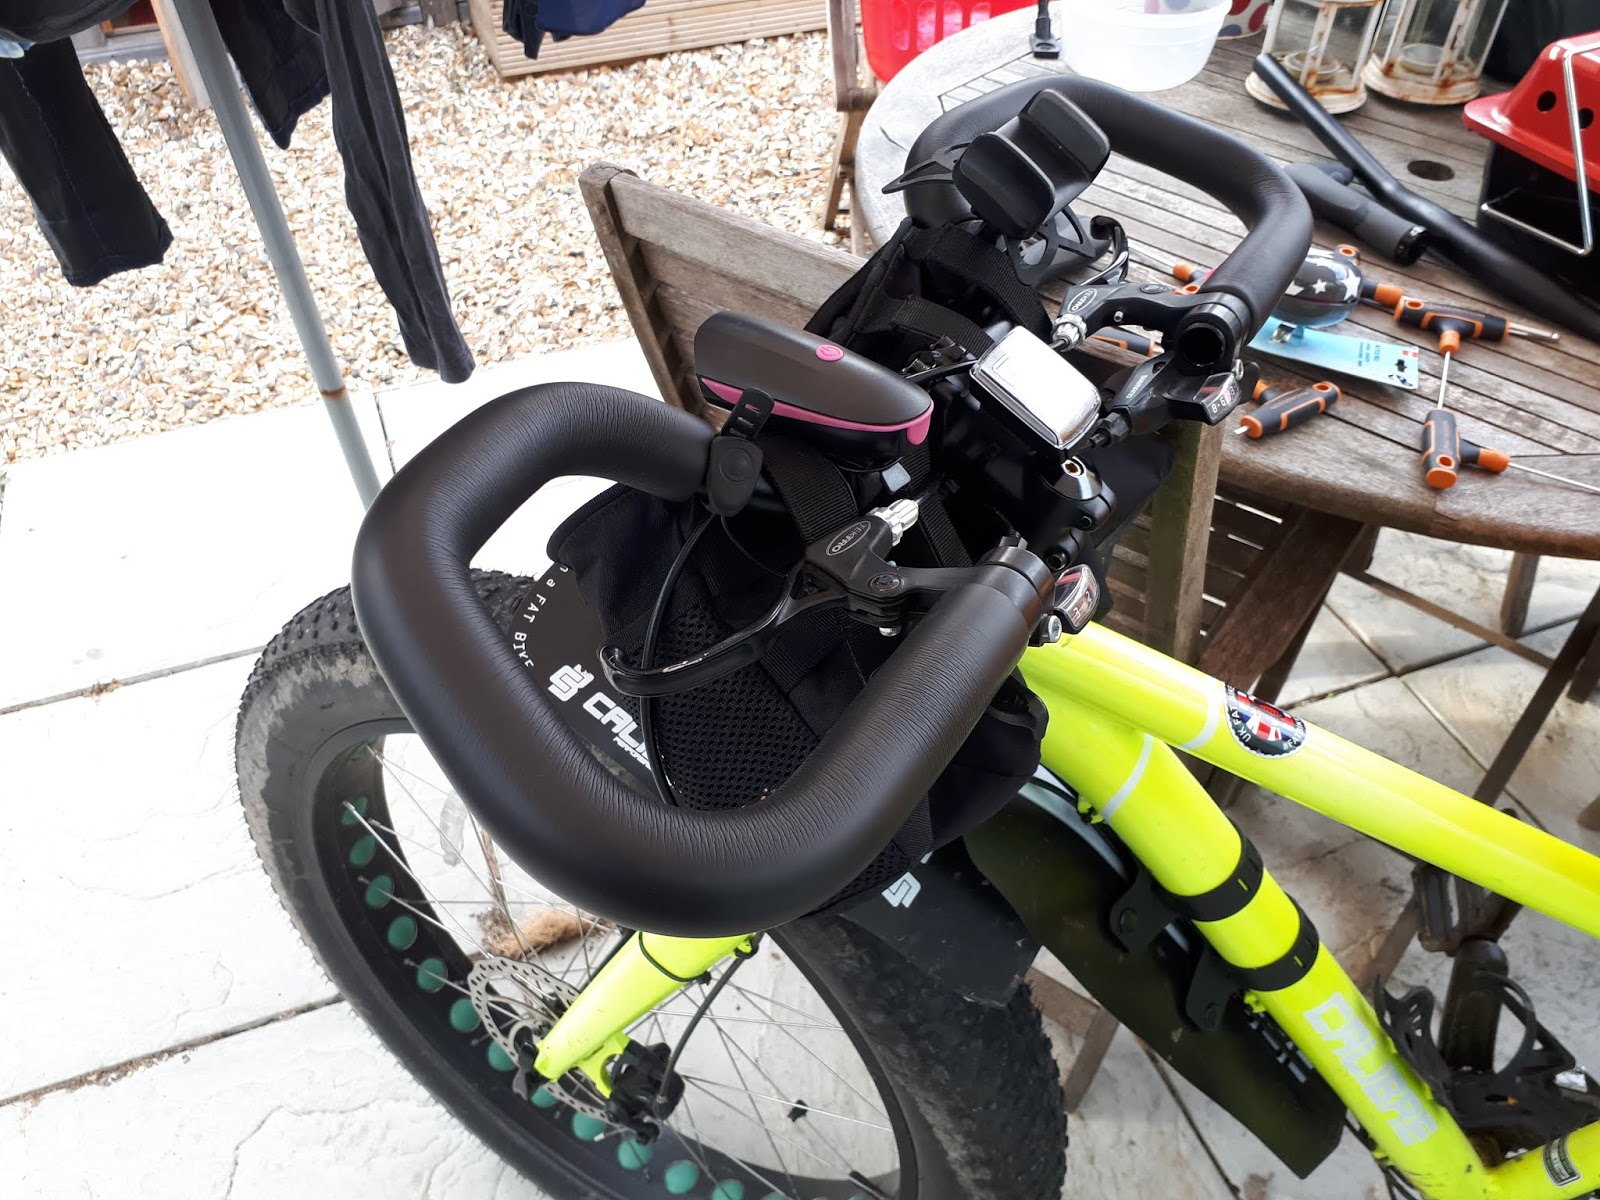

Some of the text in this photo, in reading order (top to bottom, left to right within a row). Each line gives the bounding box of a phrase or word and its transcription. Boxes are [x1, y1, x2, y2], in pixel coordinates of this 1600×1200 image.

[1071, 289, 1095, 311] TEKTRO
[832, 523, 868, 553] TEKTRO
[523, 593, 547, 623] FAT
[1230, 704, 1242, 726] FAT
[1238, 726, 1251, 742] UK
[1303, 991, 1439, 1145] CALIBRE
